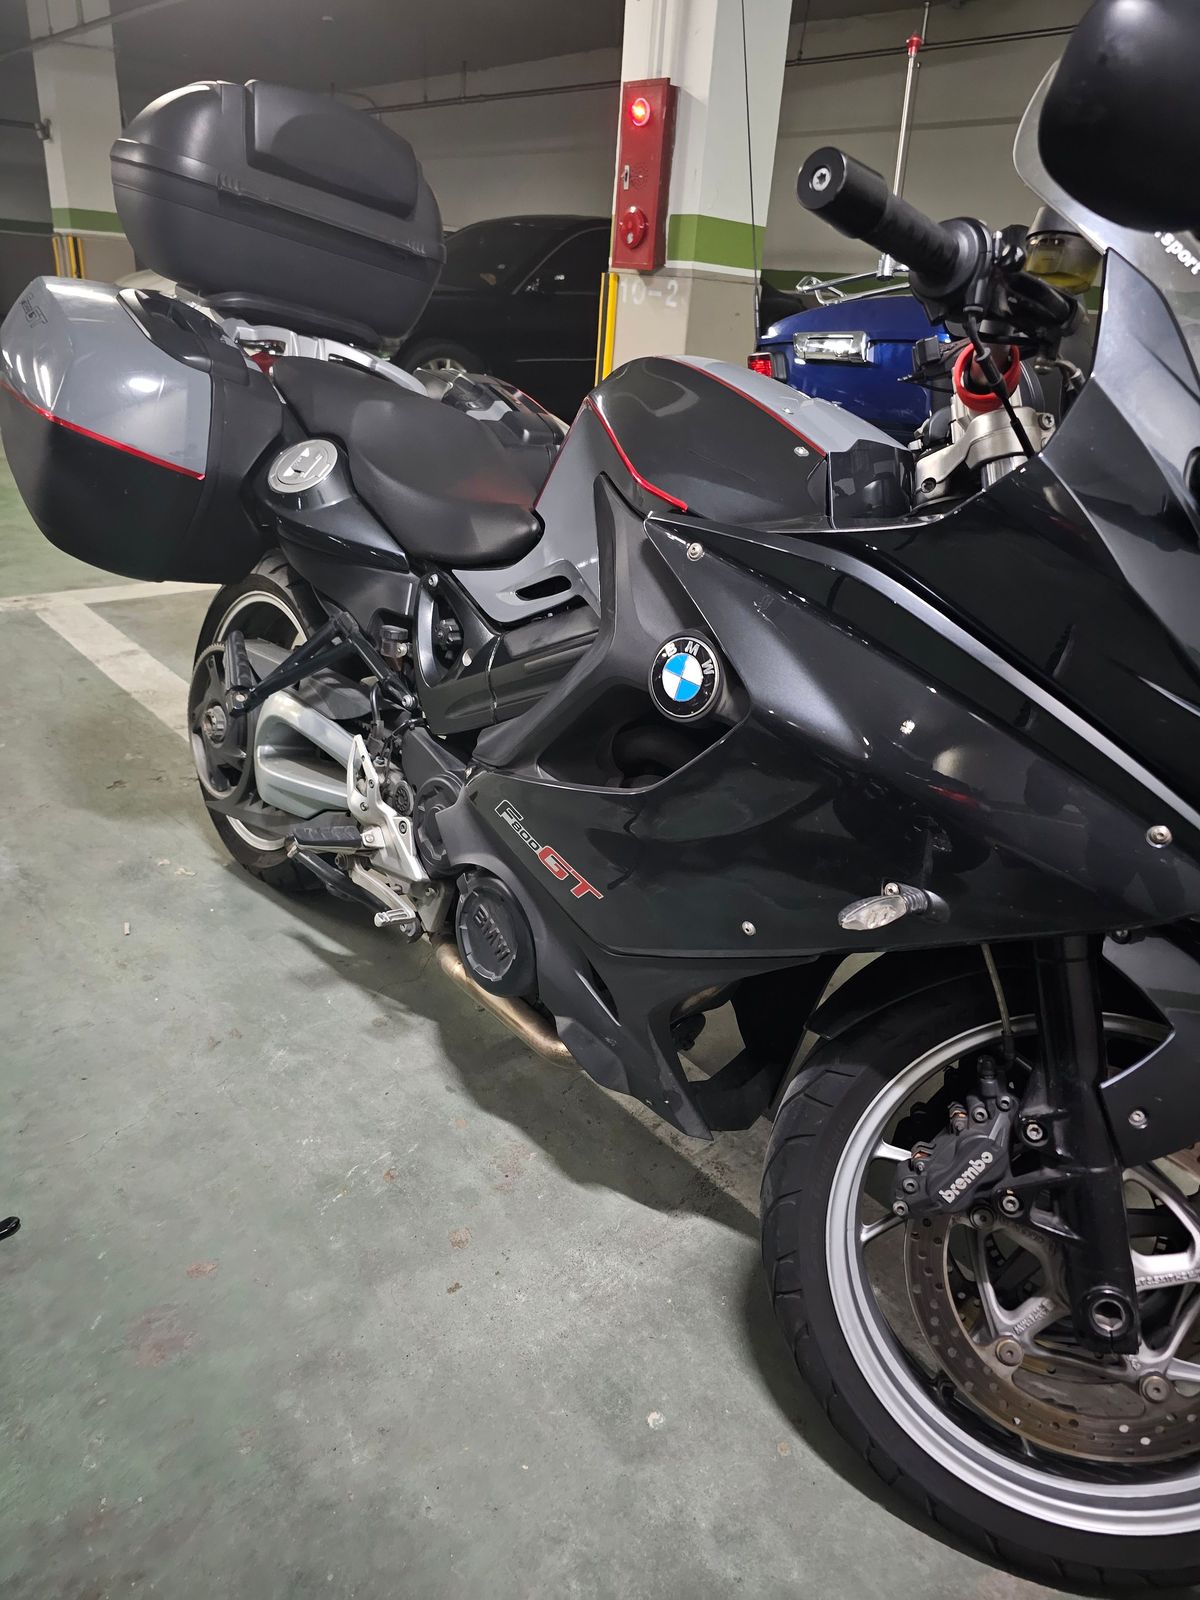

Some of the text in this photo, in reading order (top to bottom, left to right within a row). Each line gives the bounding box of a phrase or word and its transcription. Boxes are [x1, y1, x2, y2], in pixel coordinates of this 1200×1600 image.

[620, 280, 679, 308] 10-2
[664, 641, 715, 675] BMW
[473, 903, 511, 962] BMW
[938, 1151, 993, 1204] brembo
